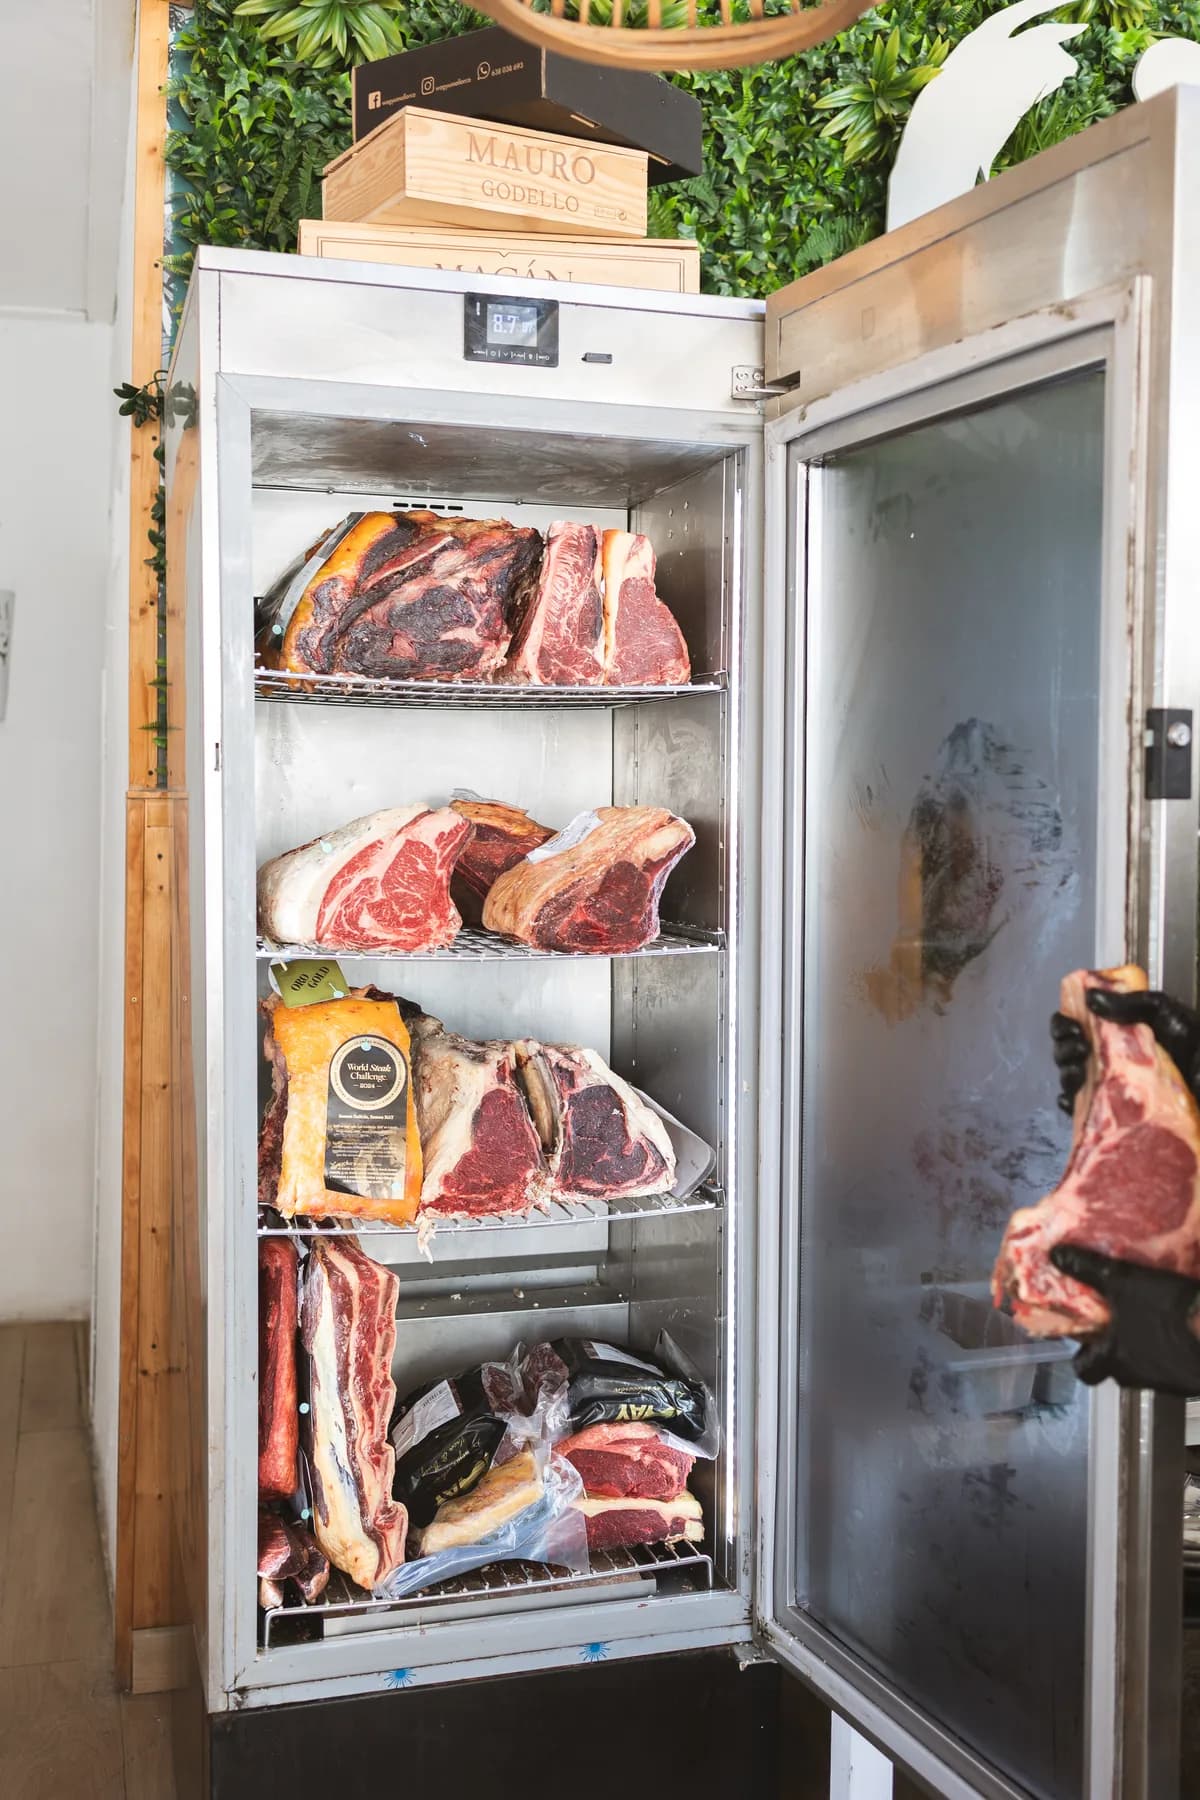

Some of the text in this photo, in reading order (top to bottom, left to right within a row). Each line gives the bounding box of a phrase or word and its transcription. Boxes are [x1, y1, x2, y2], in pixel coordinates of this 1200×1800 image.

[465, 131, 596, 185] MAURO
[481, 179, 579, 212] GODELLO
[290, 973, 310, 992] ORO
[307, 966, 330, 989] GOLD
[347, 1063, 392, 1073] World Steak
[350, 1072, 388, 1083] Challenge
